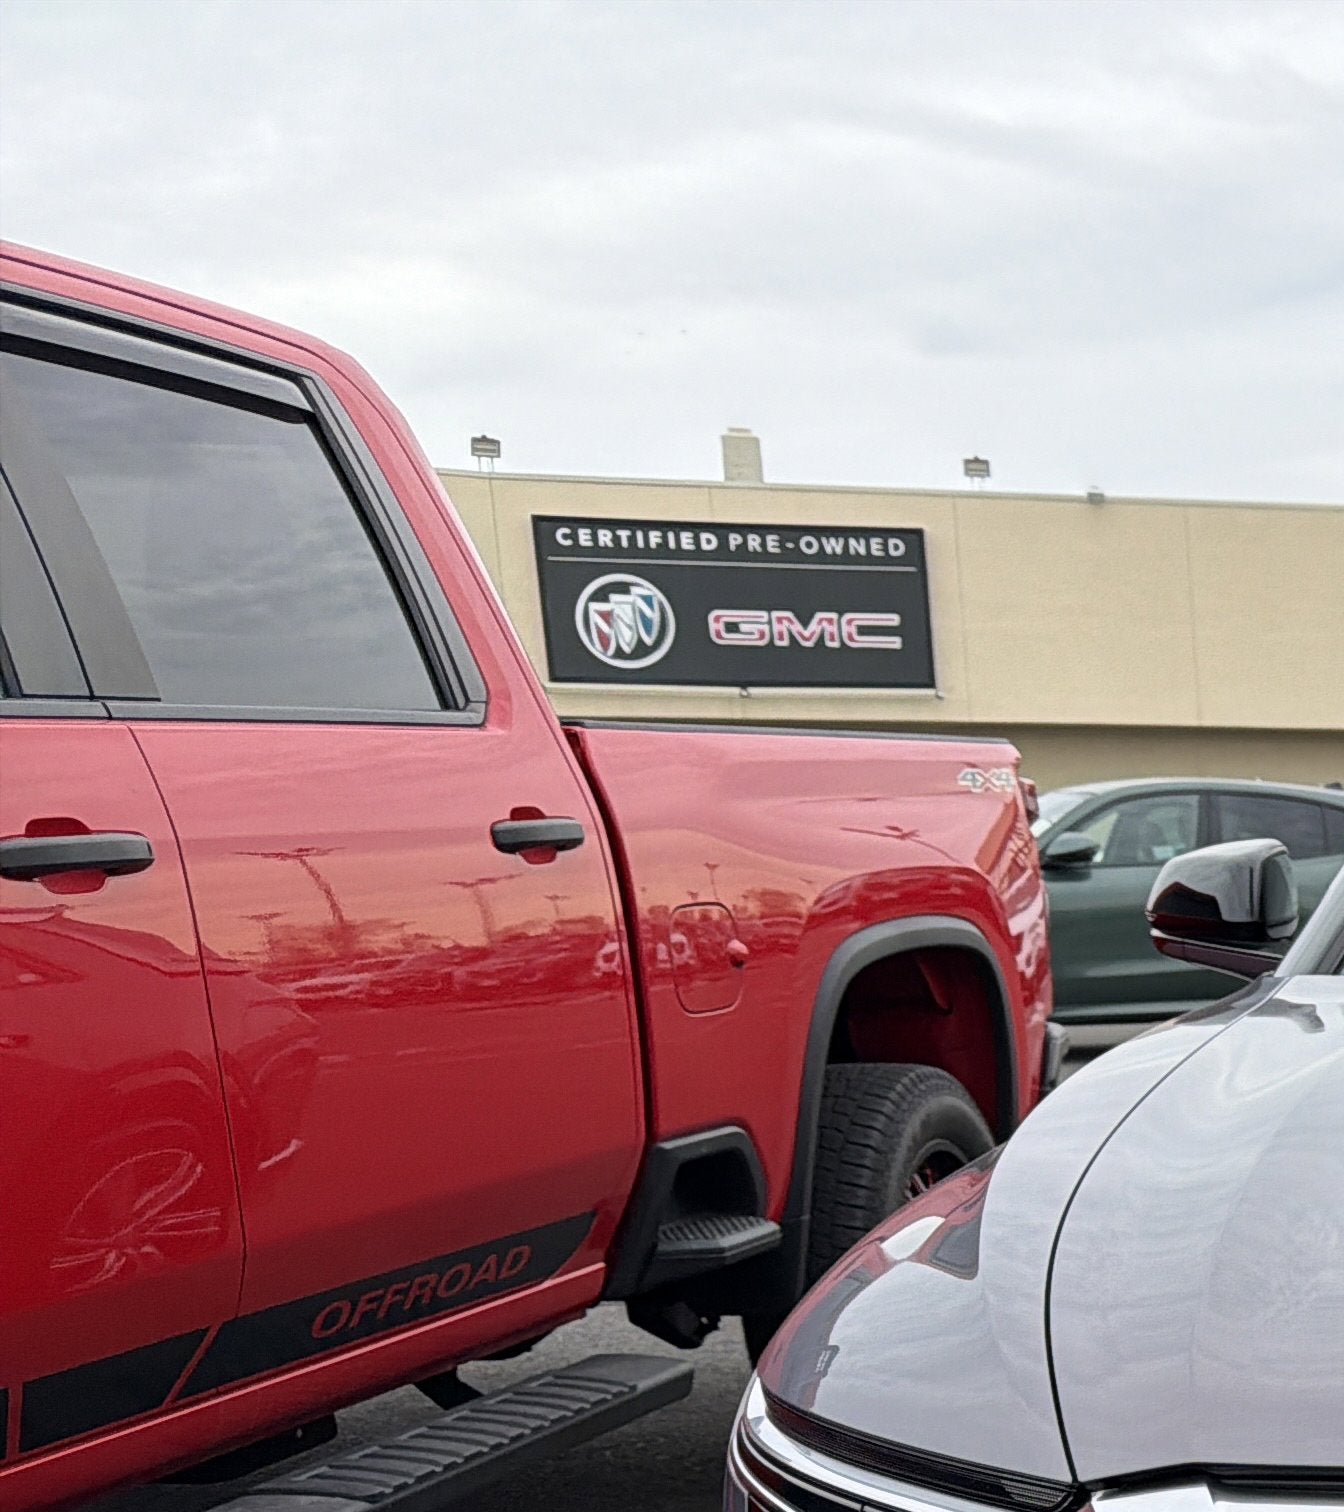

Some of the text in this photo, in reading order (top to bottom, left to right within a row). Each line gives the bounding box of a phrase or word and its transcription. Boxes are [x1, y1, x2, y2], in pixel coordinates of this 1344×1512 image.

[555, 527, 906, 557] CERTIFIED PRE-OWNED
[708, 609, 902, 650] GMC
[310, 1245, 532, 1339] OFFROAD
